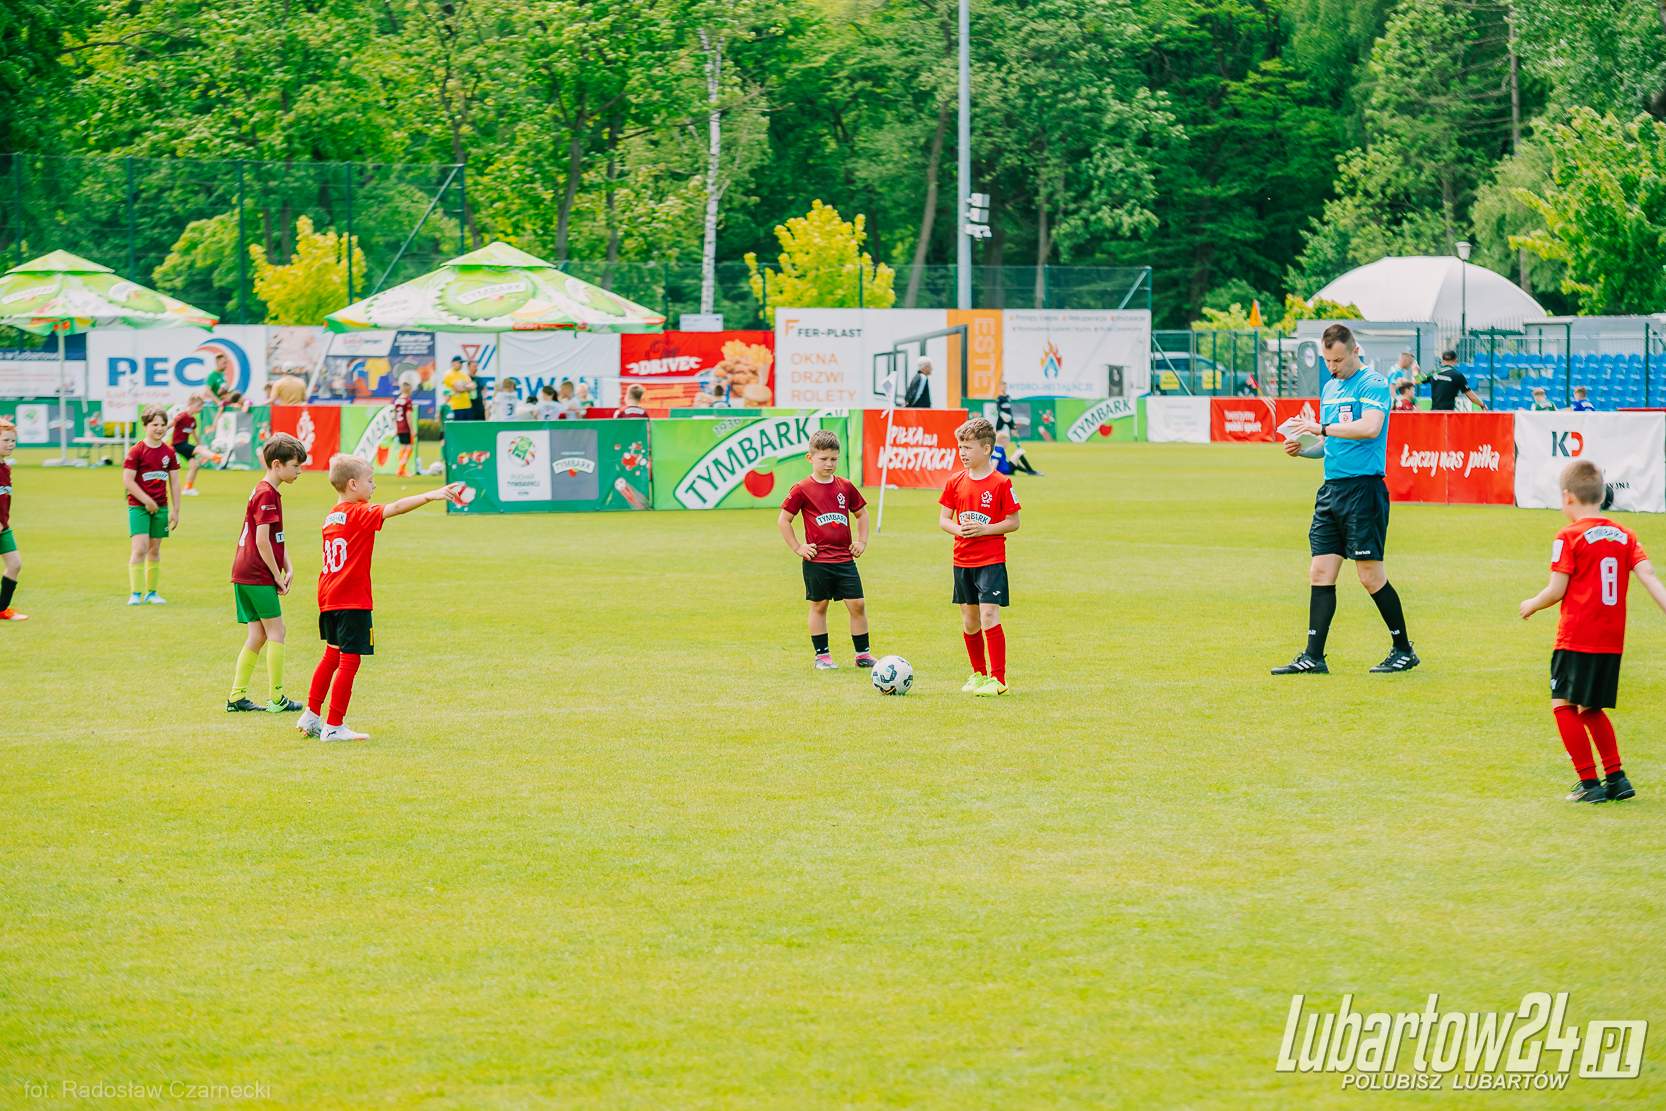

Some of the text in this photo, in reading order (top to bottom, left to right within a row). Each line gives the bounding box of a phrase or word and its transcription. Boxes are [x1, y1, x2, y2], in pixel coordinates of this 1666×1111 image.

[798, 327, 863, 338] FER-PLAST
[791, 352, 838, 365] OKNA
[107, 357, 205, 386] PEC
[791, 371, 844, 384] DRZWI
[791, 389, 857, 402] ROLETY
[1072, 399, 1132, 440] TYMBARK
[685, 416, 811, 504] TYMBARK
[1440, 450, 1465, 471] nas
[1600, 557, 1618, 606] 8
